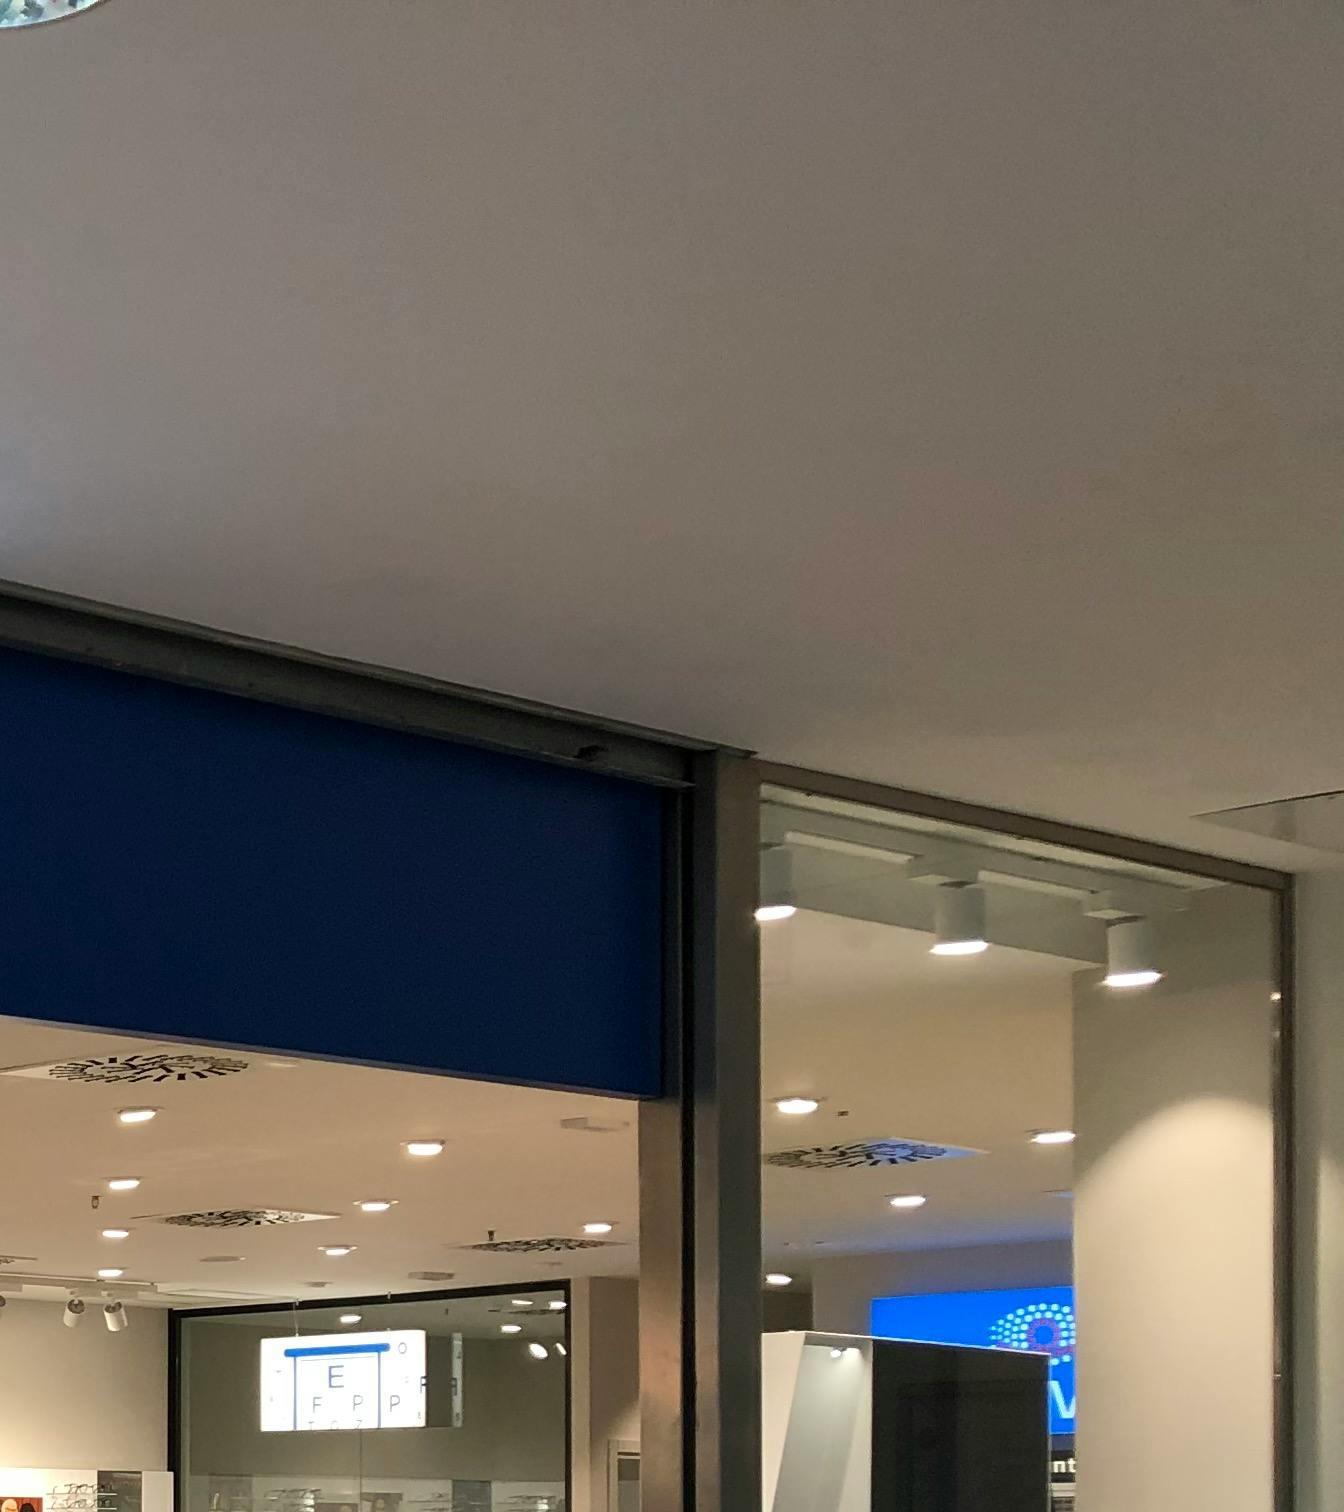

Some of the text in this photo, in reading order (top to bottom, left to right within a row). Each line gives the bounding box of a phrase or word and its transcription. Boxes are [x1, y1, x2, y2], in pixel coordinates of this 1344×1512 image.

[328, 1365, 345, 1388] E
[312, 1394, 364, 1414] F P
[389, 1394, 401, 1413] P
